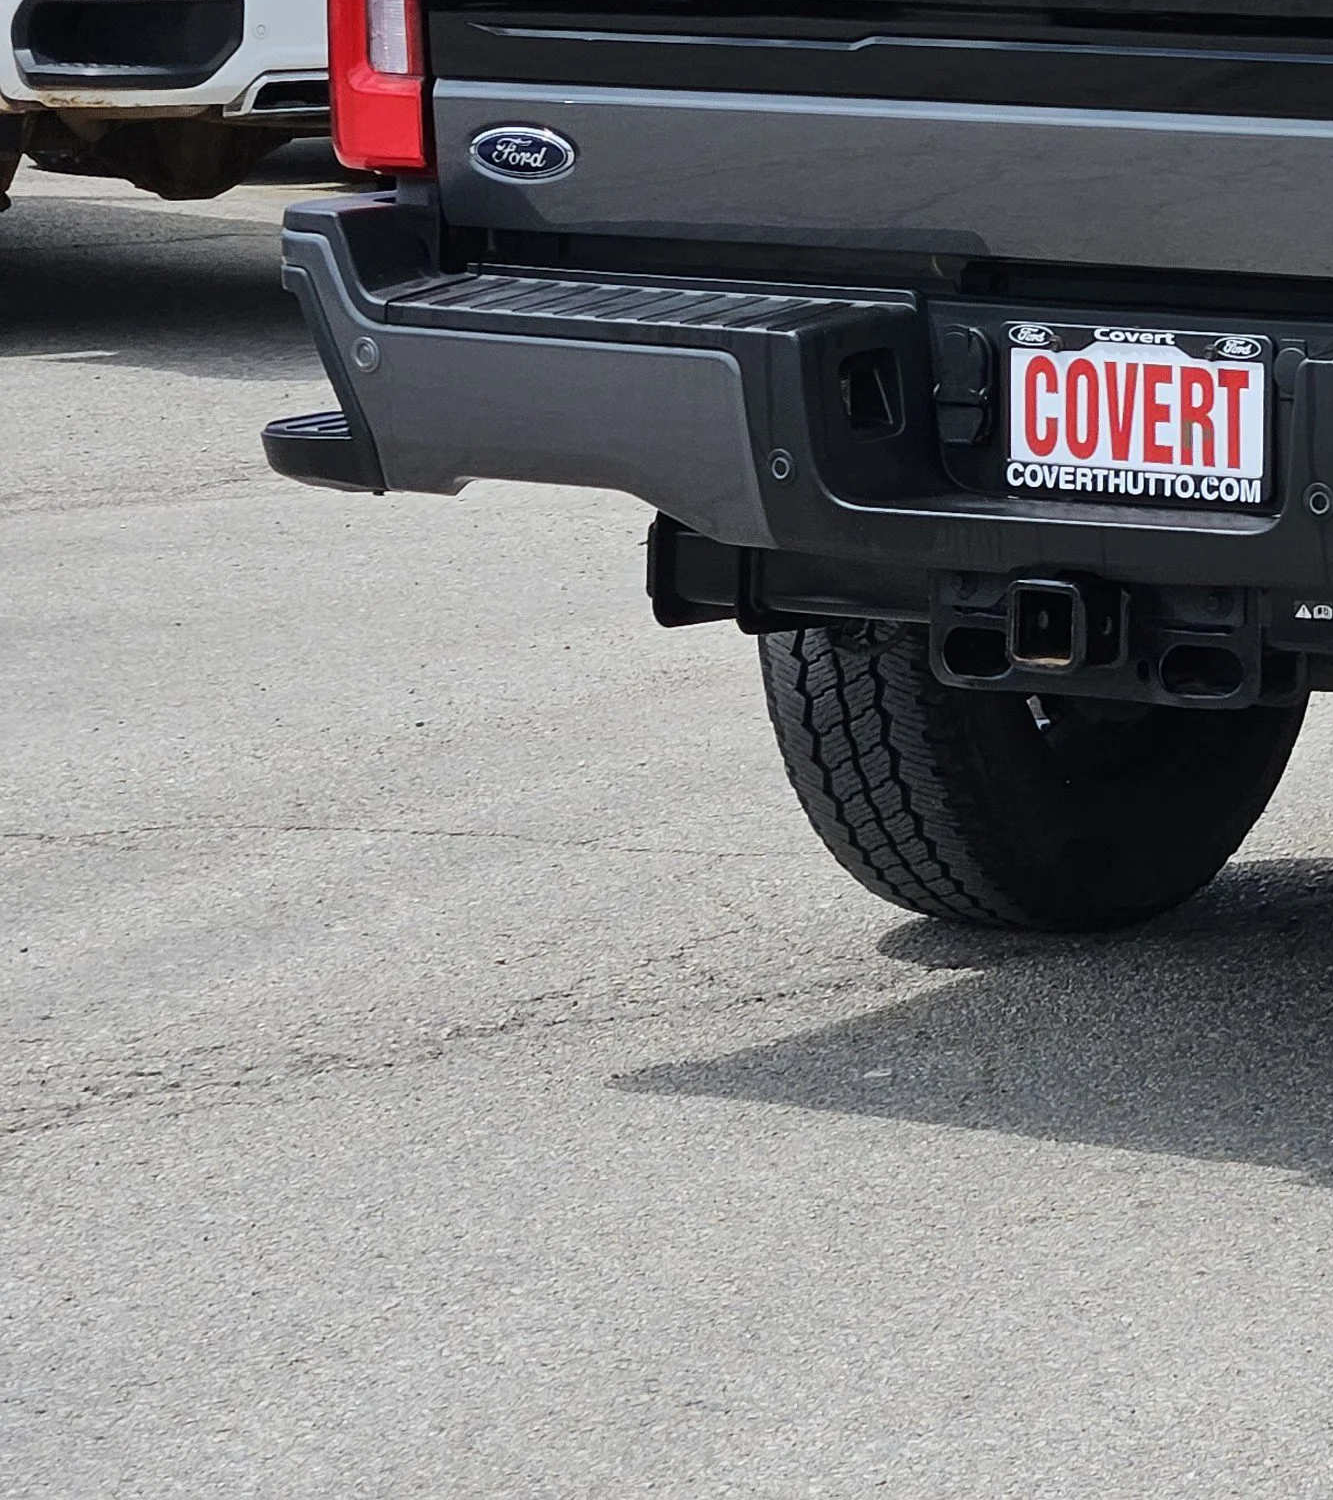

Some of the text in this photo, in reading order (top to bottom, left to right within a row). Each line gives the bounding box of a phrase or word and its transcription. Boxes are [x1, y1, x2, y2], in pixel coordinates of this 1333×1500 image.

[491, 137, 548, 168] Ford
[1093, 328, 1176, 346] Covert
[1024, 355, 1250, 470] COVERT
[1006, 462, 1262, 503] COVERTHUTTO.COM
